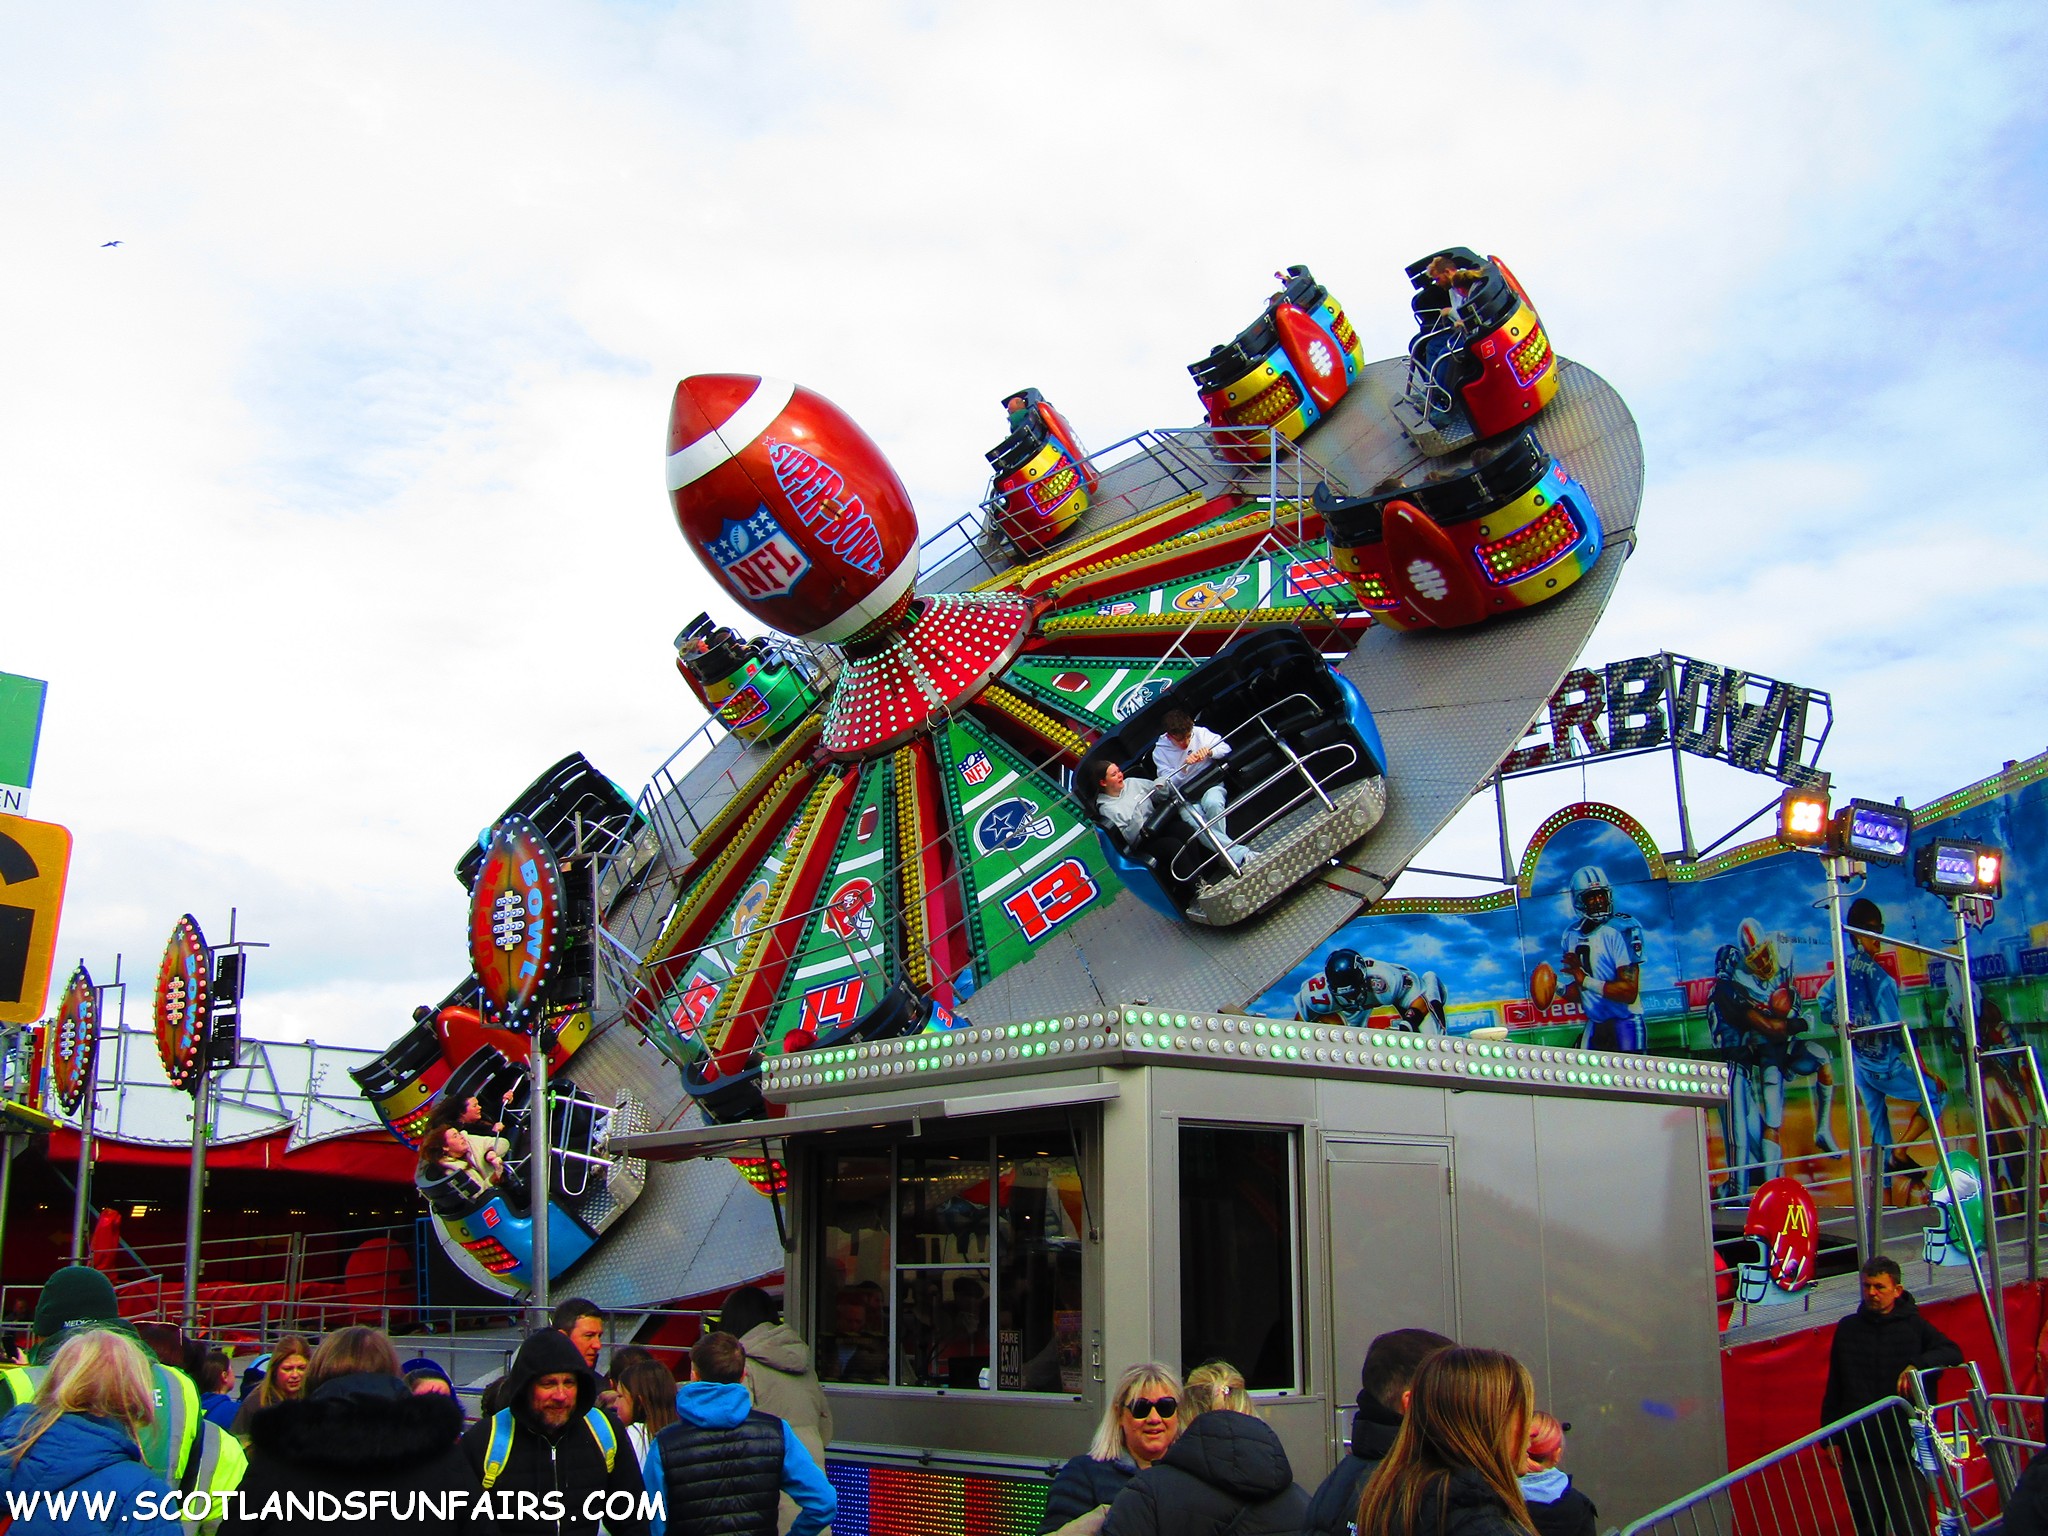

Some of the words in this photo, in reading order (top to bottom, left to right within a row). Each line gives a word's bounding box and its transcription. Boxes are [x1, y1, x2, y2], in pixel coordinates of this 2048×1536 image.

[1480, 340, 1496, 359] 6
[1553, 466, 1568, 485] 5
[729, 541, 802, 597] NFL
[964, 761, 991, 786] NFL
[1001, 856, 1101, 945] 13
[479, 859, 505, 989] SUPER
[520, 859, 543, 979] BOWL
[181, 954, 197, 1049] BOWL
[937, 1007, 953, 1028] 3
[1448, 1013, 1487, 1027] ESPN
[70, 1000, 88, 1081] BOWL
[483, 1207, 501, 1228] 2
[1781, 1204, 1808, 1238] M
[1000, 1332, 1019, 1344] FARE
[1000, 1375, 1019, 1386] EACH
